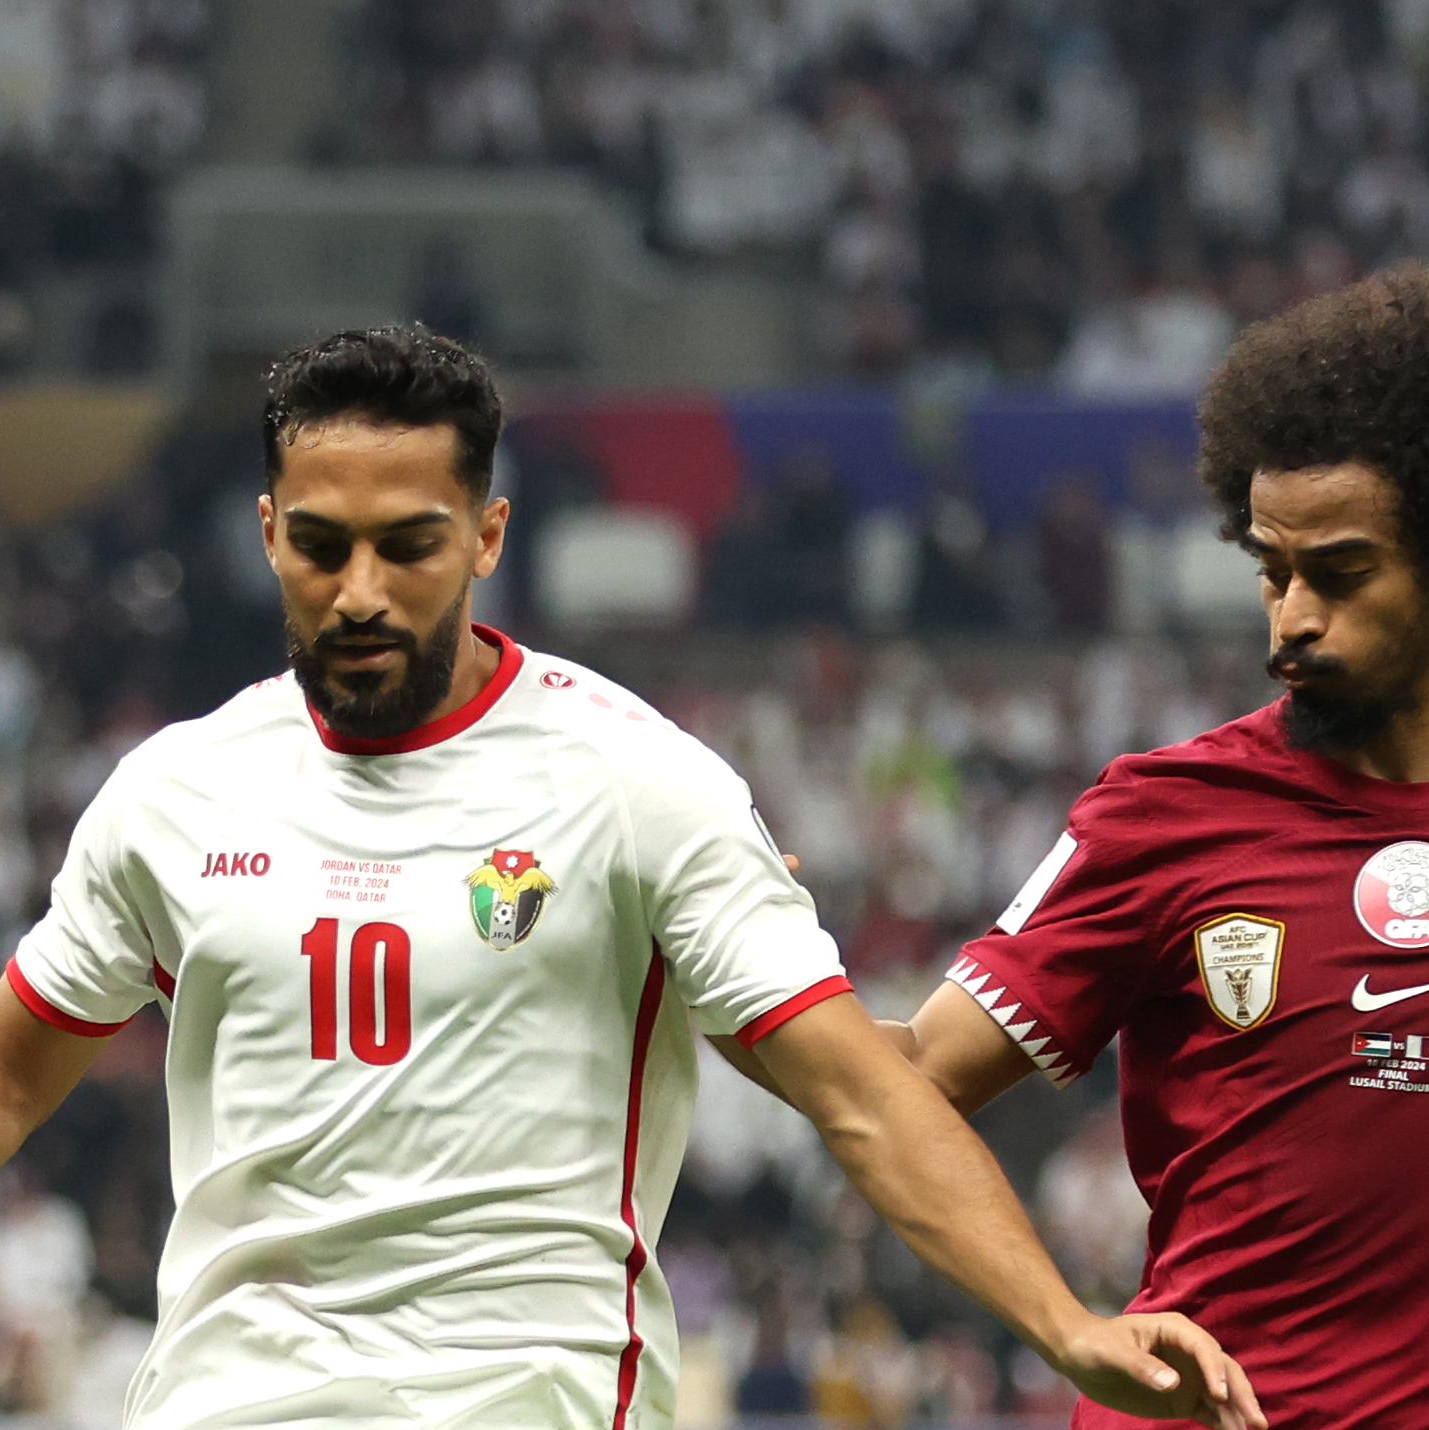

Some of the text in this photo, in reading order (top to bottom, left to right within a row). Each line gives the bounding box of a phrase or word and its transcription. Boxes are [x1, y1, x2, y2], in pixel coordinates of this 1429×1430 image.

[200, 852, 272, 878] JAKO
[320, 859, 402, 875] JORDAN VS QATAR
[330, 875, 341, 886] 10
[365, 877, 390, 889] 2024
[356, 891, 386, 903] QATAR
[1229, 925, 1247, 934] AFC
[491, 931, 513, 941] JFA
[1211, 932, 1268, 943] ASIAN CUP
[1212, 952, 1266, 965] CHAMPIONS
[300, 916, 413, 1067] 10
[1381, 1059, 1400, 1068] FEB
[1400, 1060, 1427, 1071] 2024
[1378, 1069, 1410, 1081] FINAL
[1349, 1076, 1386, 1089] LUSAIL
